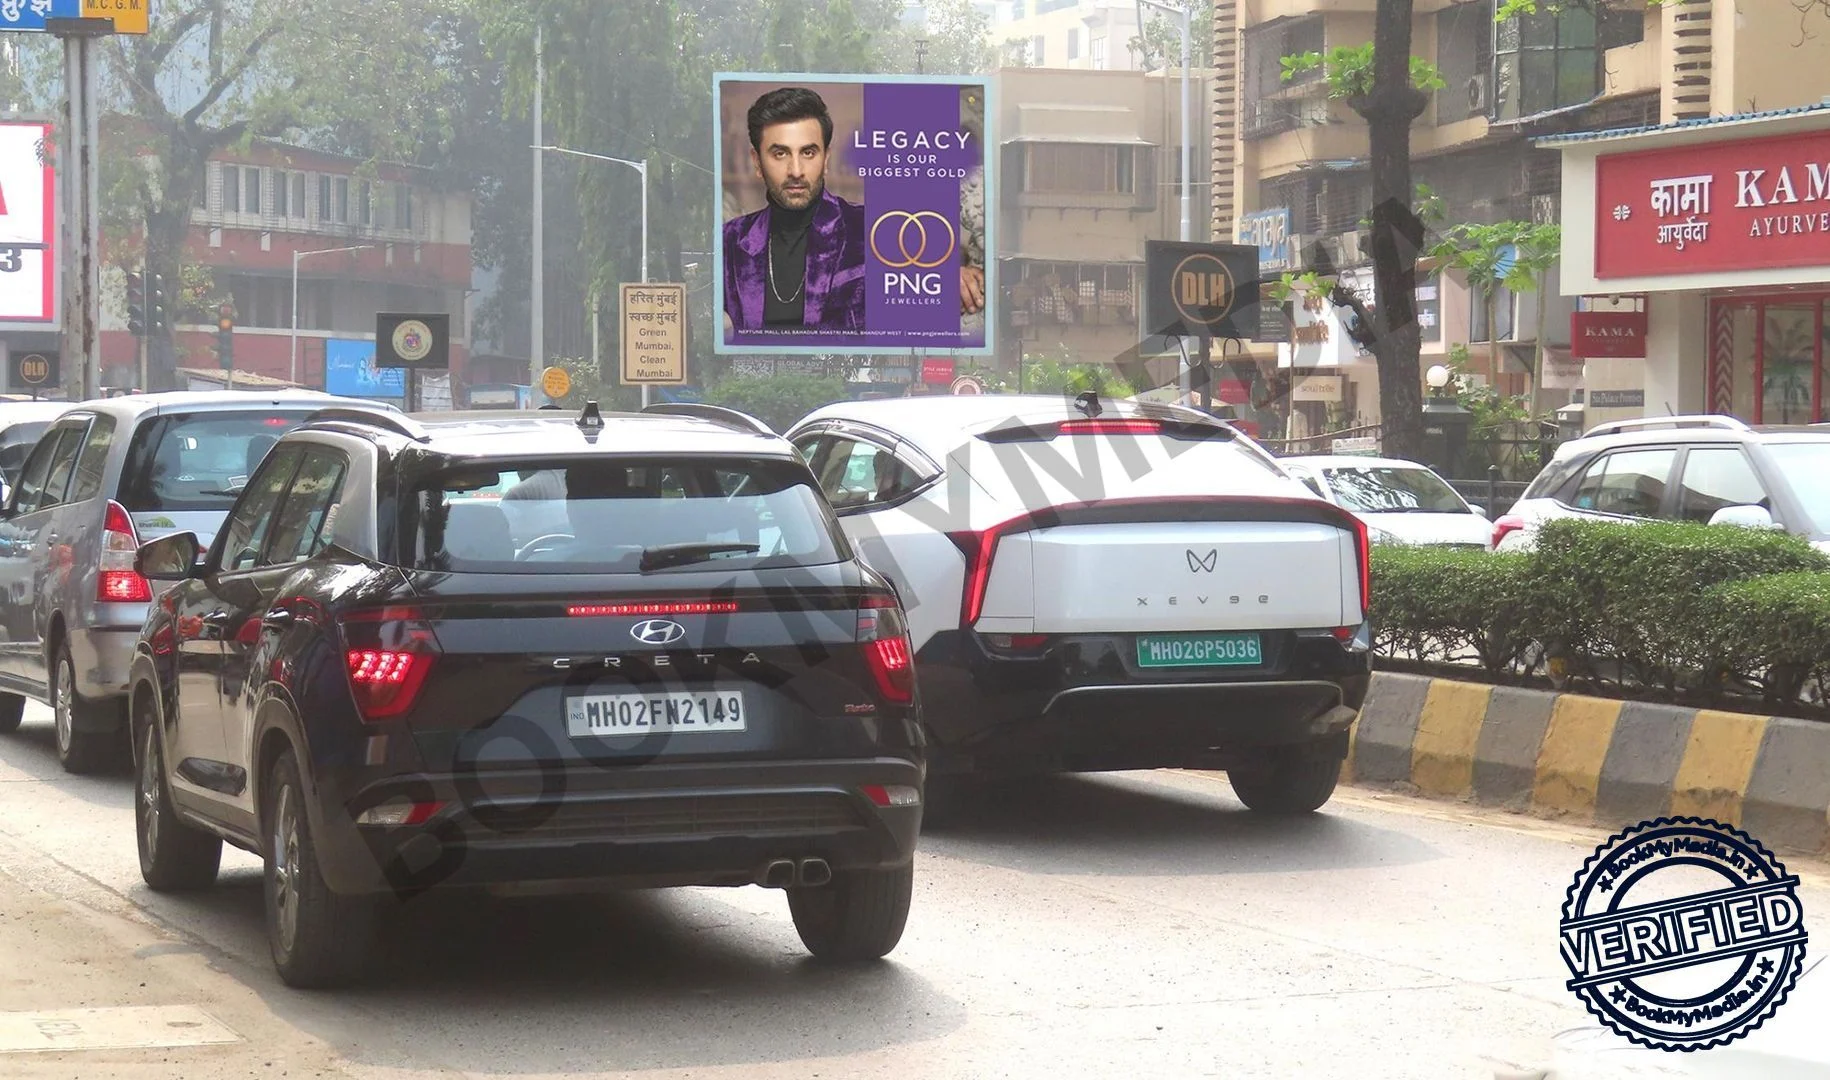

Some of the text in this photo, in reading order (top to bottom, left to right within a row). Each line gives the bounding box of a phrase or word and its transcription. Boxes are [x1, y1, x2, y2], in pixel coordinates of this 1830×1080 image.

[854, 130, 970, 149] LEGACY
[887, 154, 937, 164] IS OUR
[858, 167, 966, 178] BIGGEST GOLD
[1650, 174, 1713, 218] कामा
[1656, 215, 1709, 250] आयुर्वेदा
[884, 272, 942, 295] PNG
[1181, 271, 1226, 308] DLH
[629, 290, 678, 307] हरित मुंबई
[884, 297, 941, 305] JEWELLERS
[628, 309, 678, 325] स्वच्छ मुंबई
[638, 328, 667, 337] Green
[1584, 326, 1635, 337] KAMA
[635, 341, 674, 351] Mumbai,
[639, 355, 666, 364] Clean
[24, 361, 45, 376] DLH
[636, 369, 673, 378] Mumbai
[1150, 639, 1258, 661] MH02GP5036
[552, 651, 761, 670] CRETA
[586, 696, 741, 728] MH02FN2149
